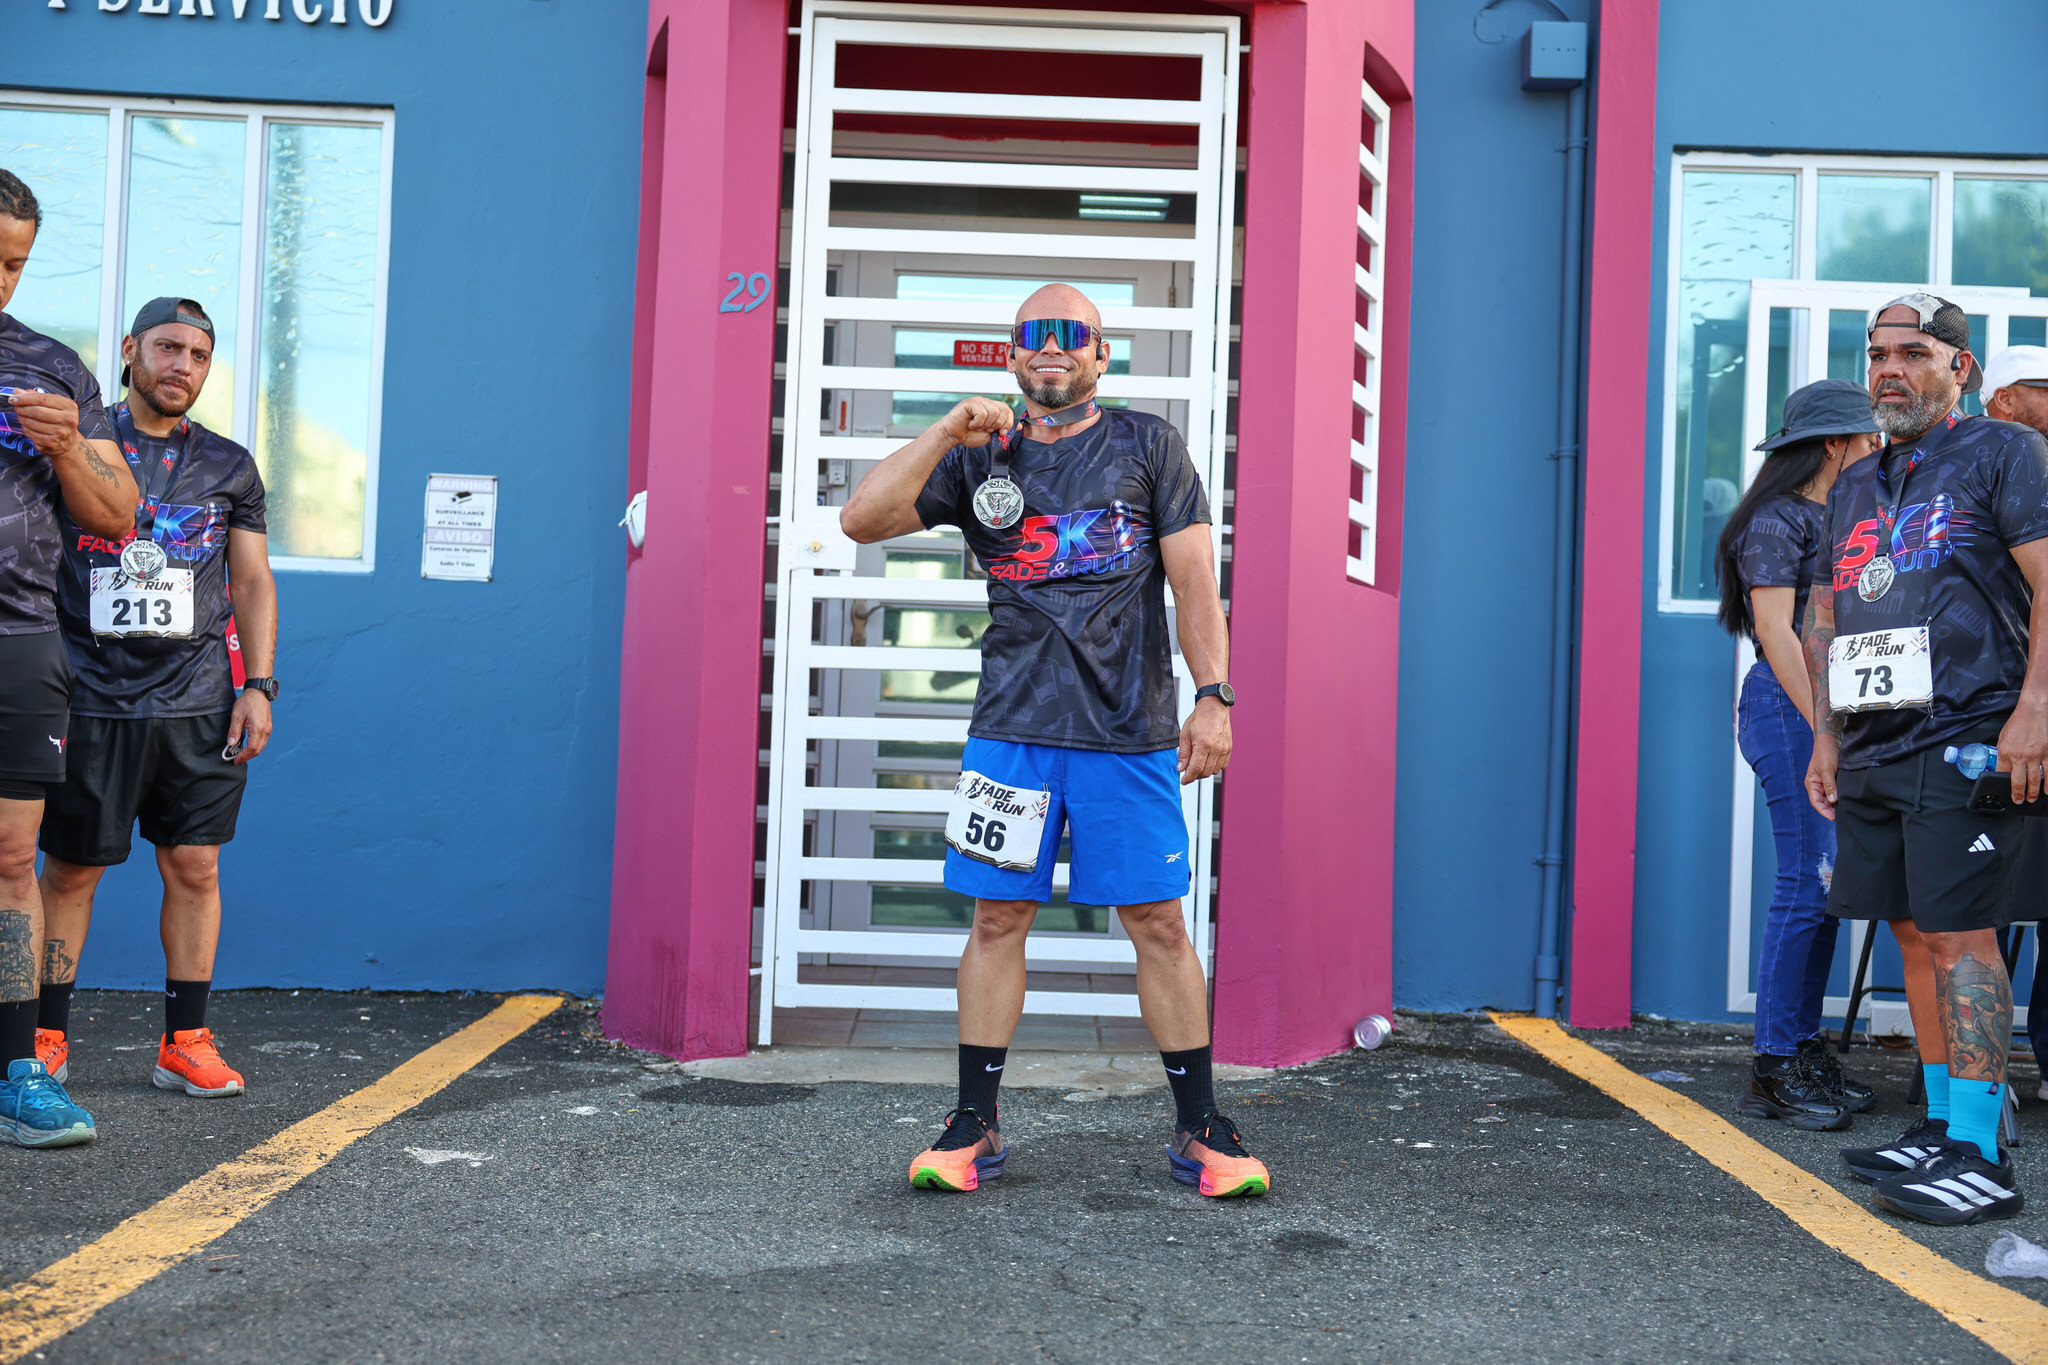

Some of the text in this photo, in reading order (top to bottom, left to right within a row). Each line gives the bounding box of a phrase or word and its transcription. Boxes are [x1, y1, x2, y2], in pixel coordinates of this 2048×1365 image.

[720, 271, 771, 313] 29
[961, 343, 977, 354] NO
[981, 343, 995, 355] SE
[961, 354, 993, 363] VENTAS
[77, 535, 133, 554] FAD
[434, 530, 483, 543] AVISO
[1012, 509, 1108, 562] 5K
[1050, 562, 1069, 578] &
[144, 580, 174, 592] RUN
[112, 598, 172, 626] 213
[1860, 633, 1893, 649] FADE
[1875, 644, 1905, 657] RUN
[1855, 665, 1894, 698] 73
[980, 782, 1016, 802] FADE
[984, 797, 1026, 816] & RUN
[965, 811, 1007, 852] 56
